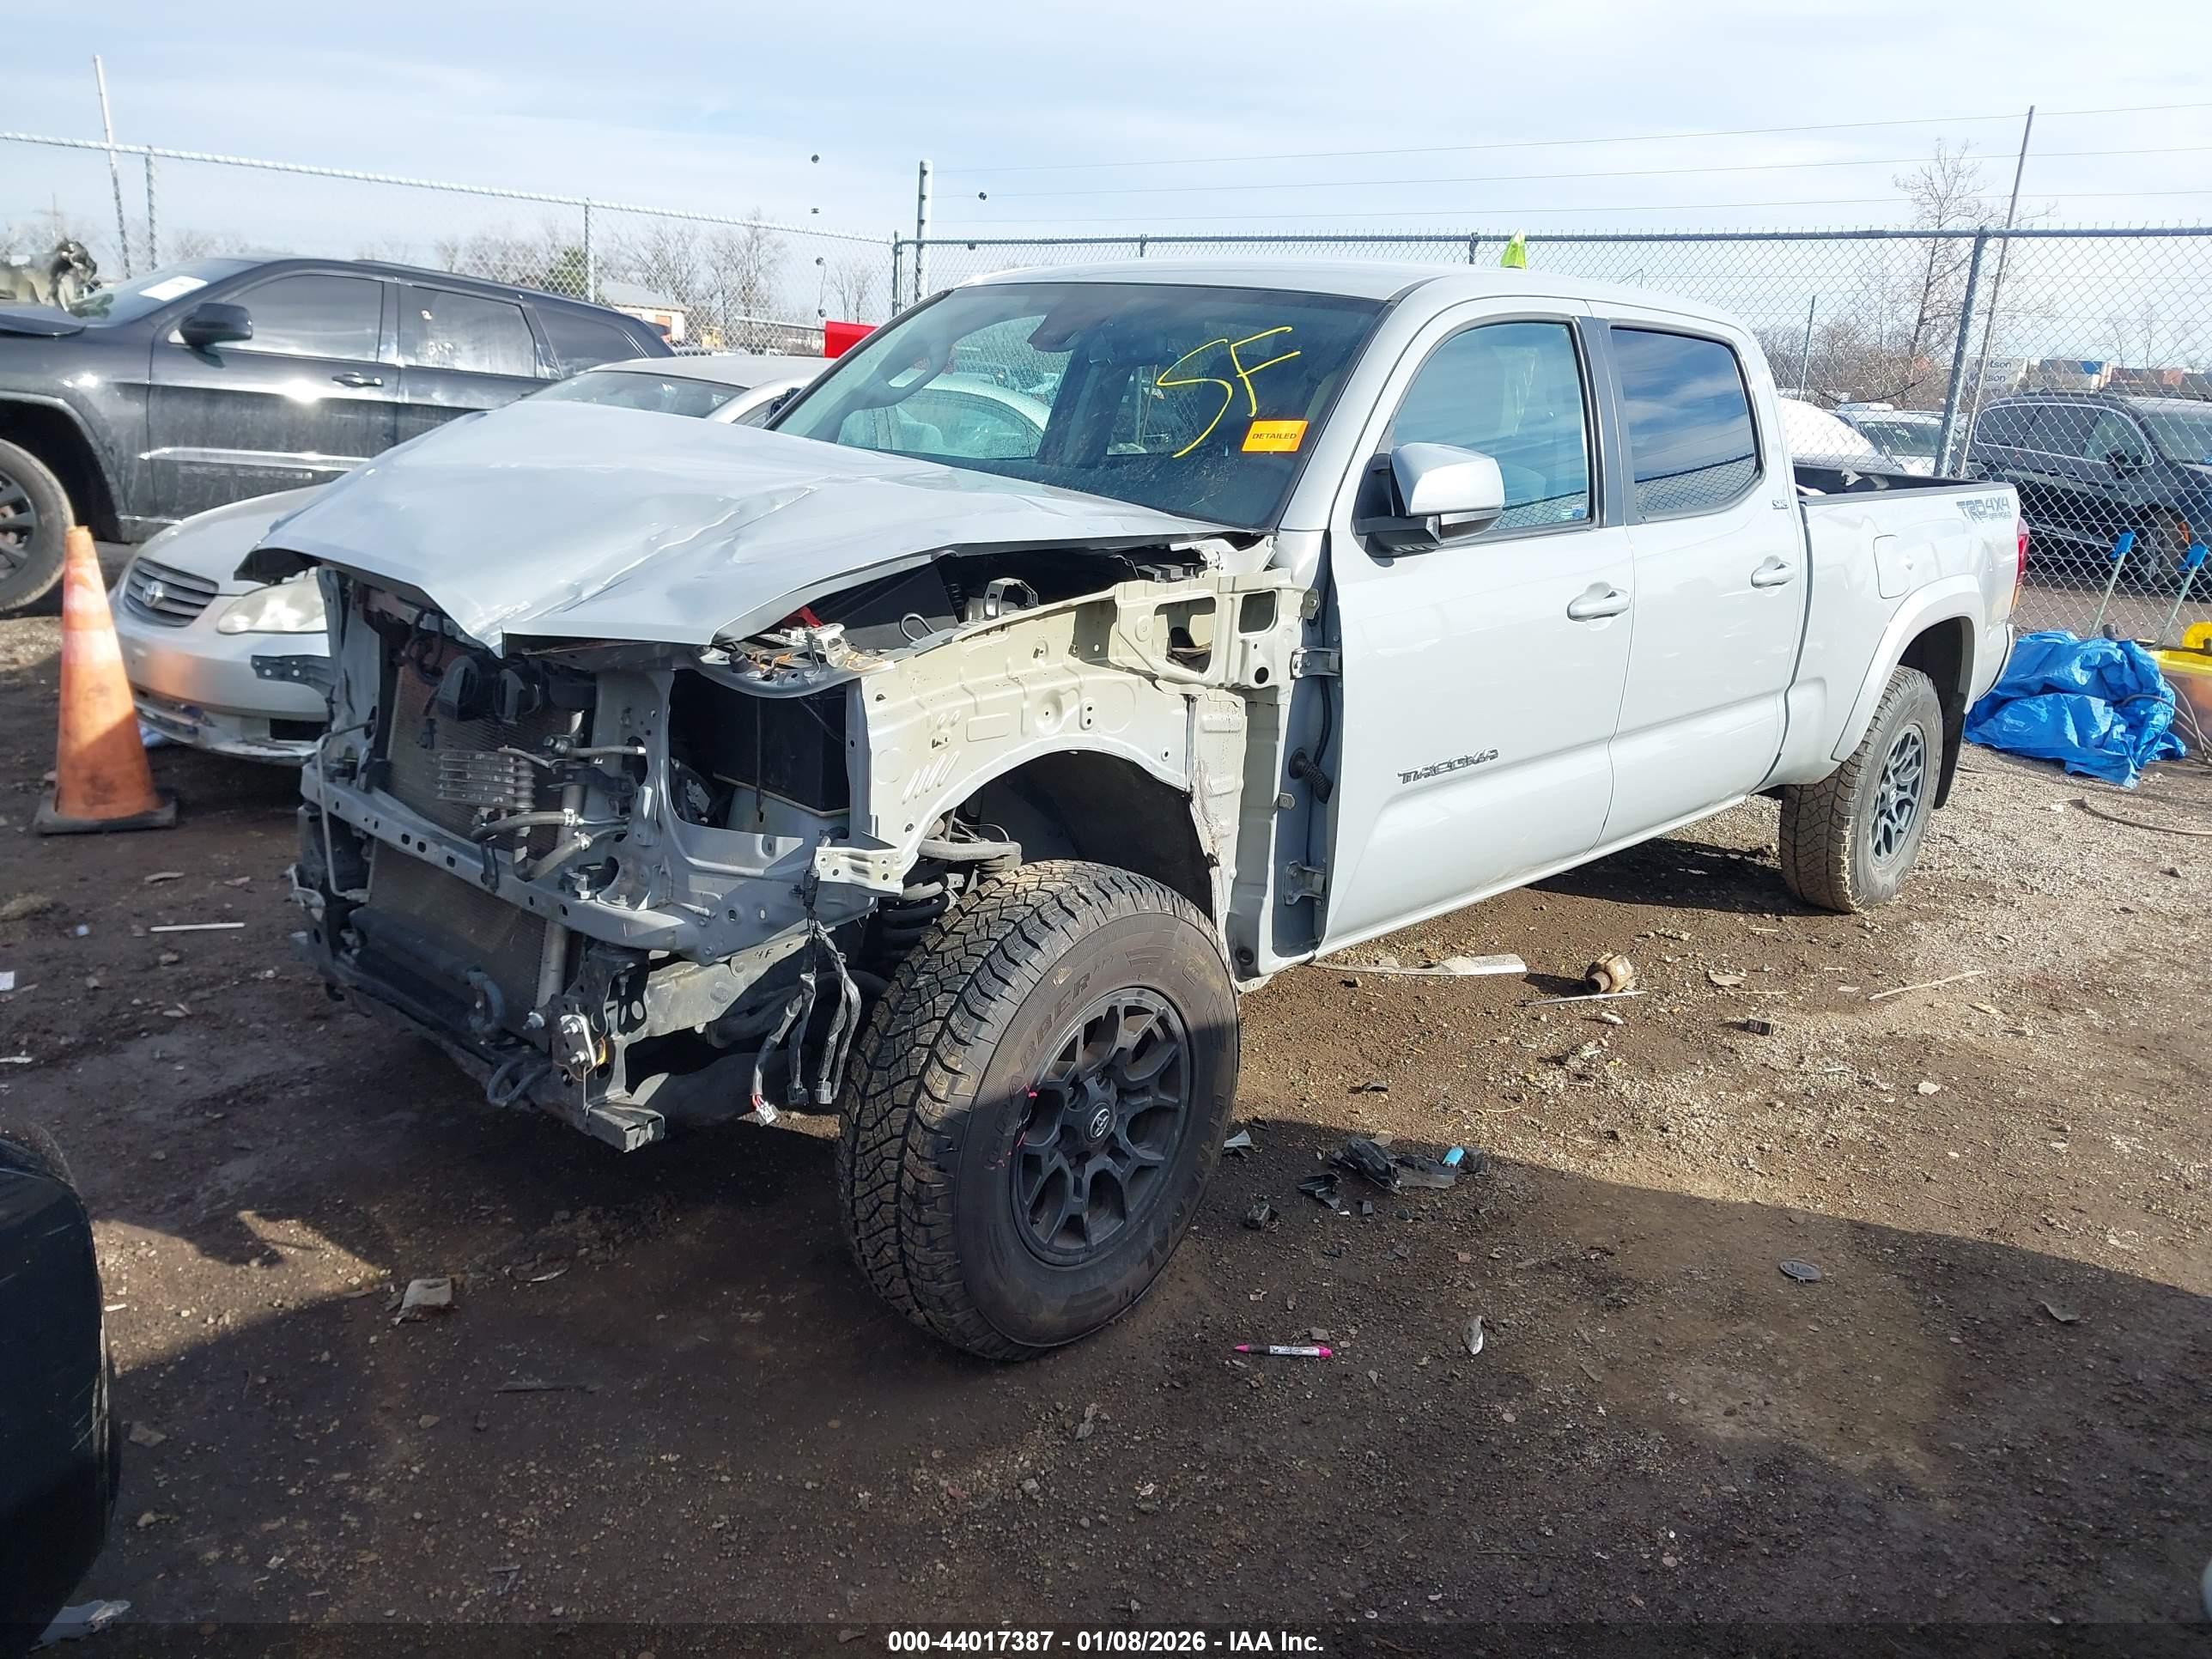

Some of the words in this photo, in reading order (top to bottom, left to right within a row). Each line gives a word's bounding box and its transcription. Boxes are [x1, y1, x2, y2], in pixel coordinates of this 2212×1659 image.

[1973, 359, 2012, 369] Mtson
[1969, 372, 2006, 384] Mtson
[1156, 325, 1301, 459] SF
[1251, 432, 1297, 441] DETAILED
[1956, 499, 1988, 523] TRD
[1396, 748, 1499, 785] TACOMA
